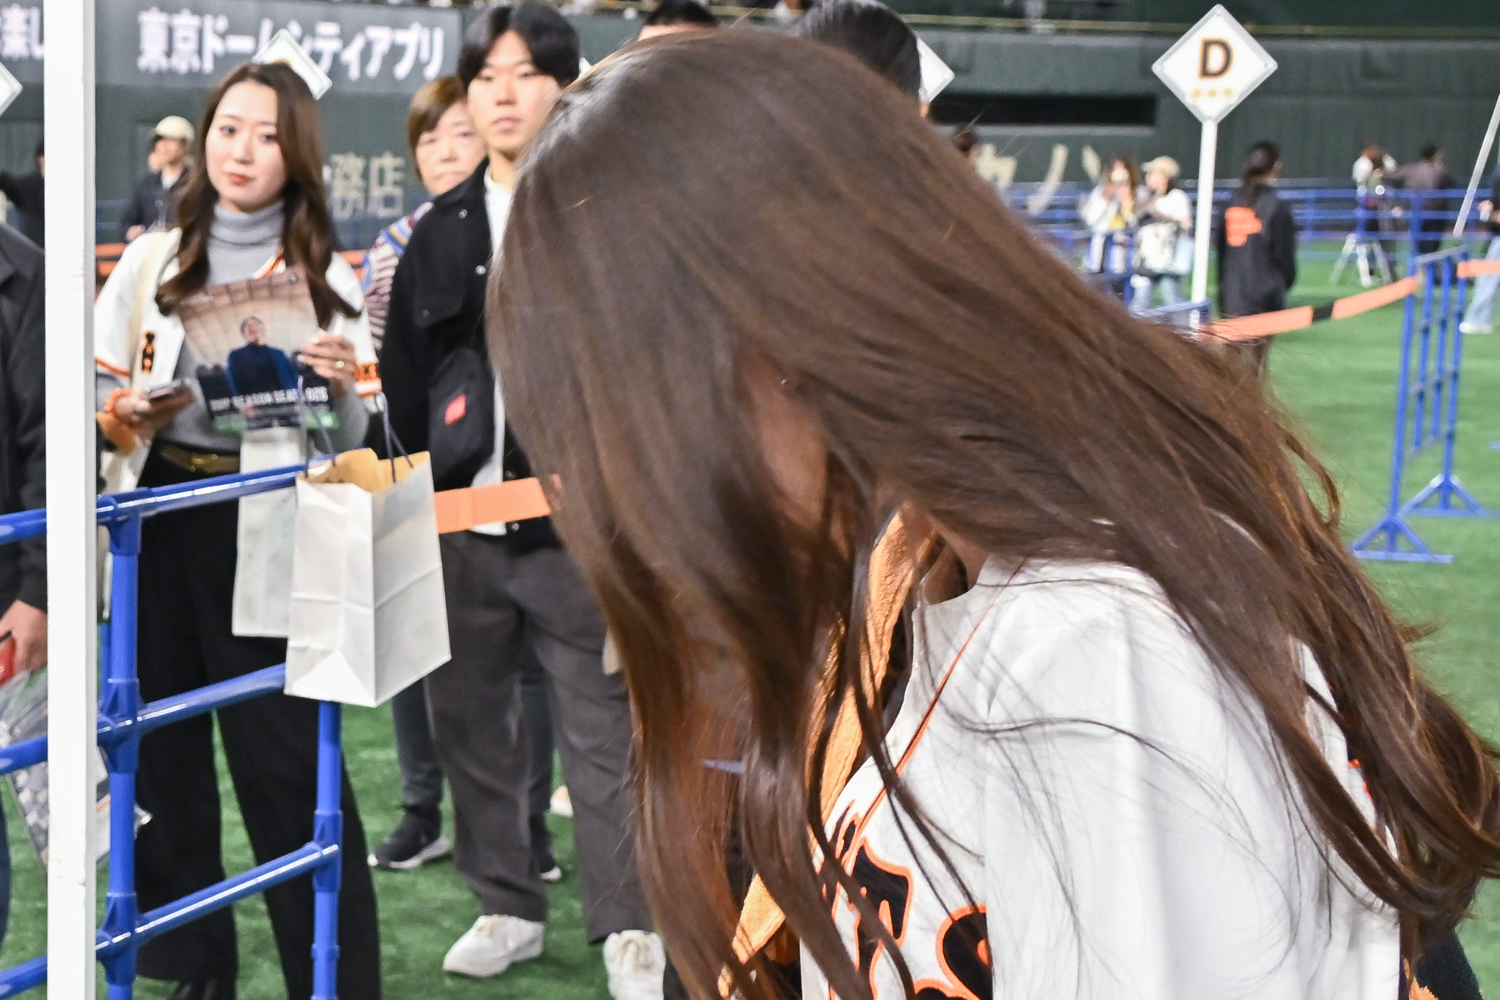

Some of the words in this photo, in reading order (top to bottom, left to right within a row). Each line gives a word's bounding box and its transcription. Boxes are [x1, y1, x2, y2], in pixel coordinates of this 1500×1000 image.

[137, 8, 445, 80] 東京ドーティアプリ
[1199, 38, 1234, 79] D
